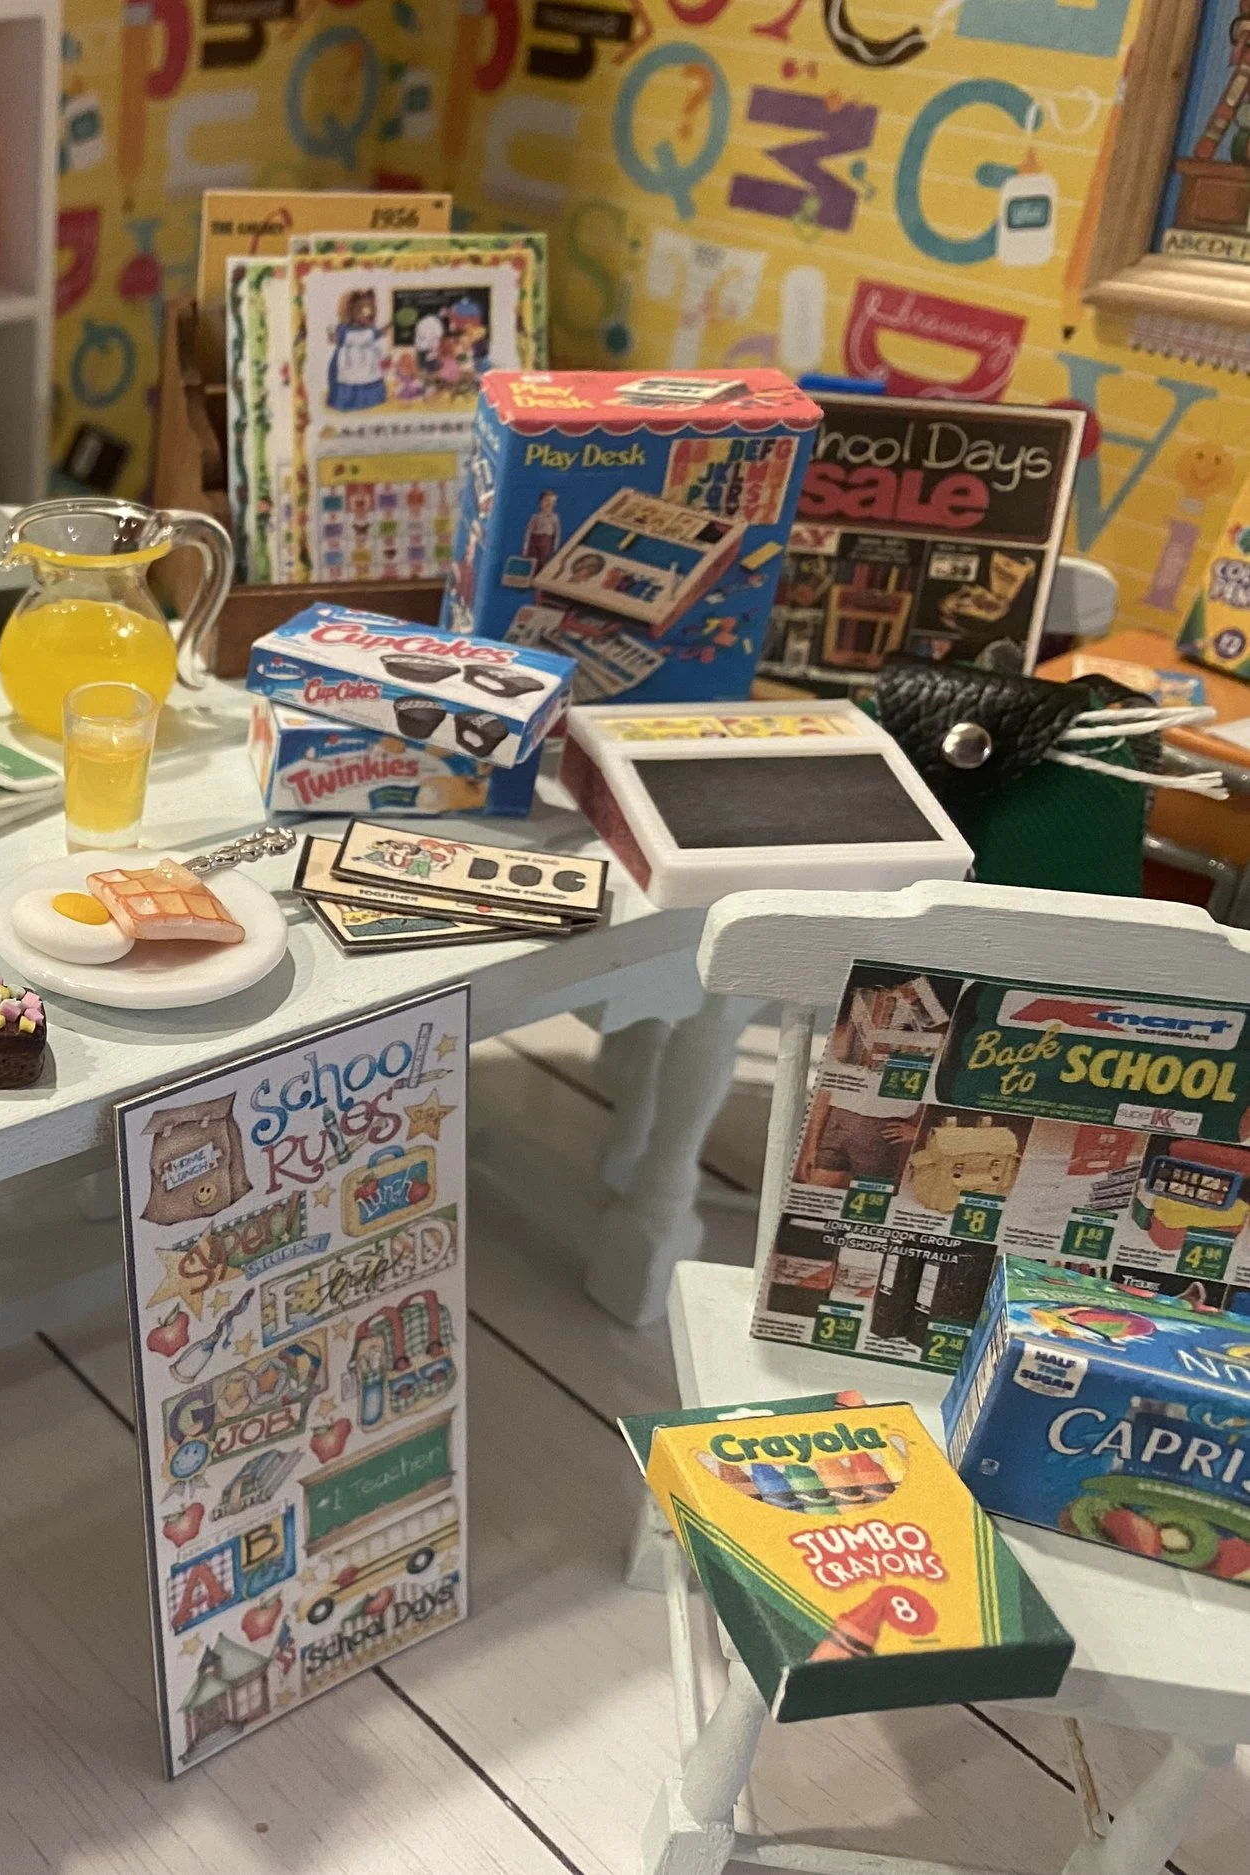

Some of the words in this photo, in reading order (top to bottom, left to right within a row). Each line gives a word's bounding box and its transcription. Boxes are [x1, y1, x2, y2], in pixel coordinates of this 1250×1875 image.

[524, 444, 580, 469] Play
[582, 443, 646, 468] Desk
[816, 422, 915, 467] hool
[921, 421, 1052, 492] Days
[287, 757, 420, 804] Twinkies
[357, 888, 419, 902] TOGETHER
[967, 1023, 1063, 1070] Back
[1059, 1044, 1238, 1102] SCHOOL
[1000, 1064, 1037, 1095] to
[250, 1022, 434, 1147] School
[262, 1089, 403, 1195] Rules
[244, 1234, 330, 1276] STUDENT
[822, 1235, 846, 1246] OLD
[824, 1220, 851, 1232] JOIN
[853, 1223, 917, 1243] FACEBOOK
[919, 1234, 963, 1249] GROUP
[1020, 1368, 1075, 1392] SUGAR
[1034, 1351, 1076, 1369] HALF
[216, 1407, 296, 1455] JOB
[708, 1421, 888, 1464] Crayola
[350, 1442, 444, 1497] Teacher
[791, 1521, 928, 1566] JUMBO
[814, 1550, 944, 1588] CRAYONS
[306, 1612, 386, 1673] School
[393, 1584, 456, 1627] Days
[889, 1595, 919, 1624] 8
